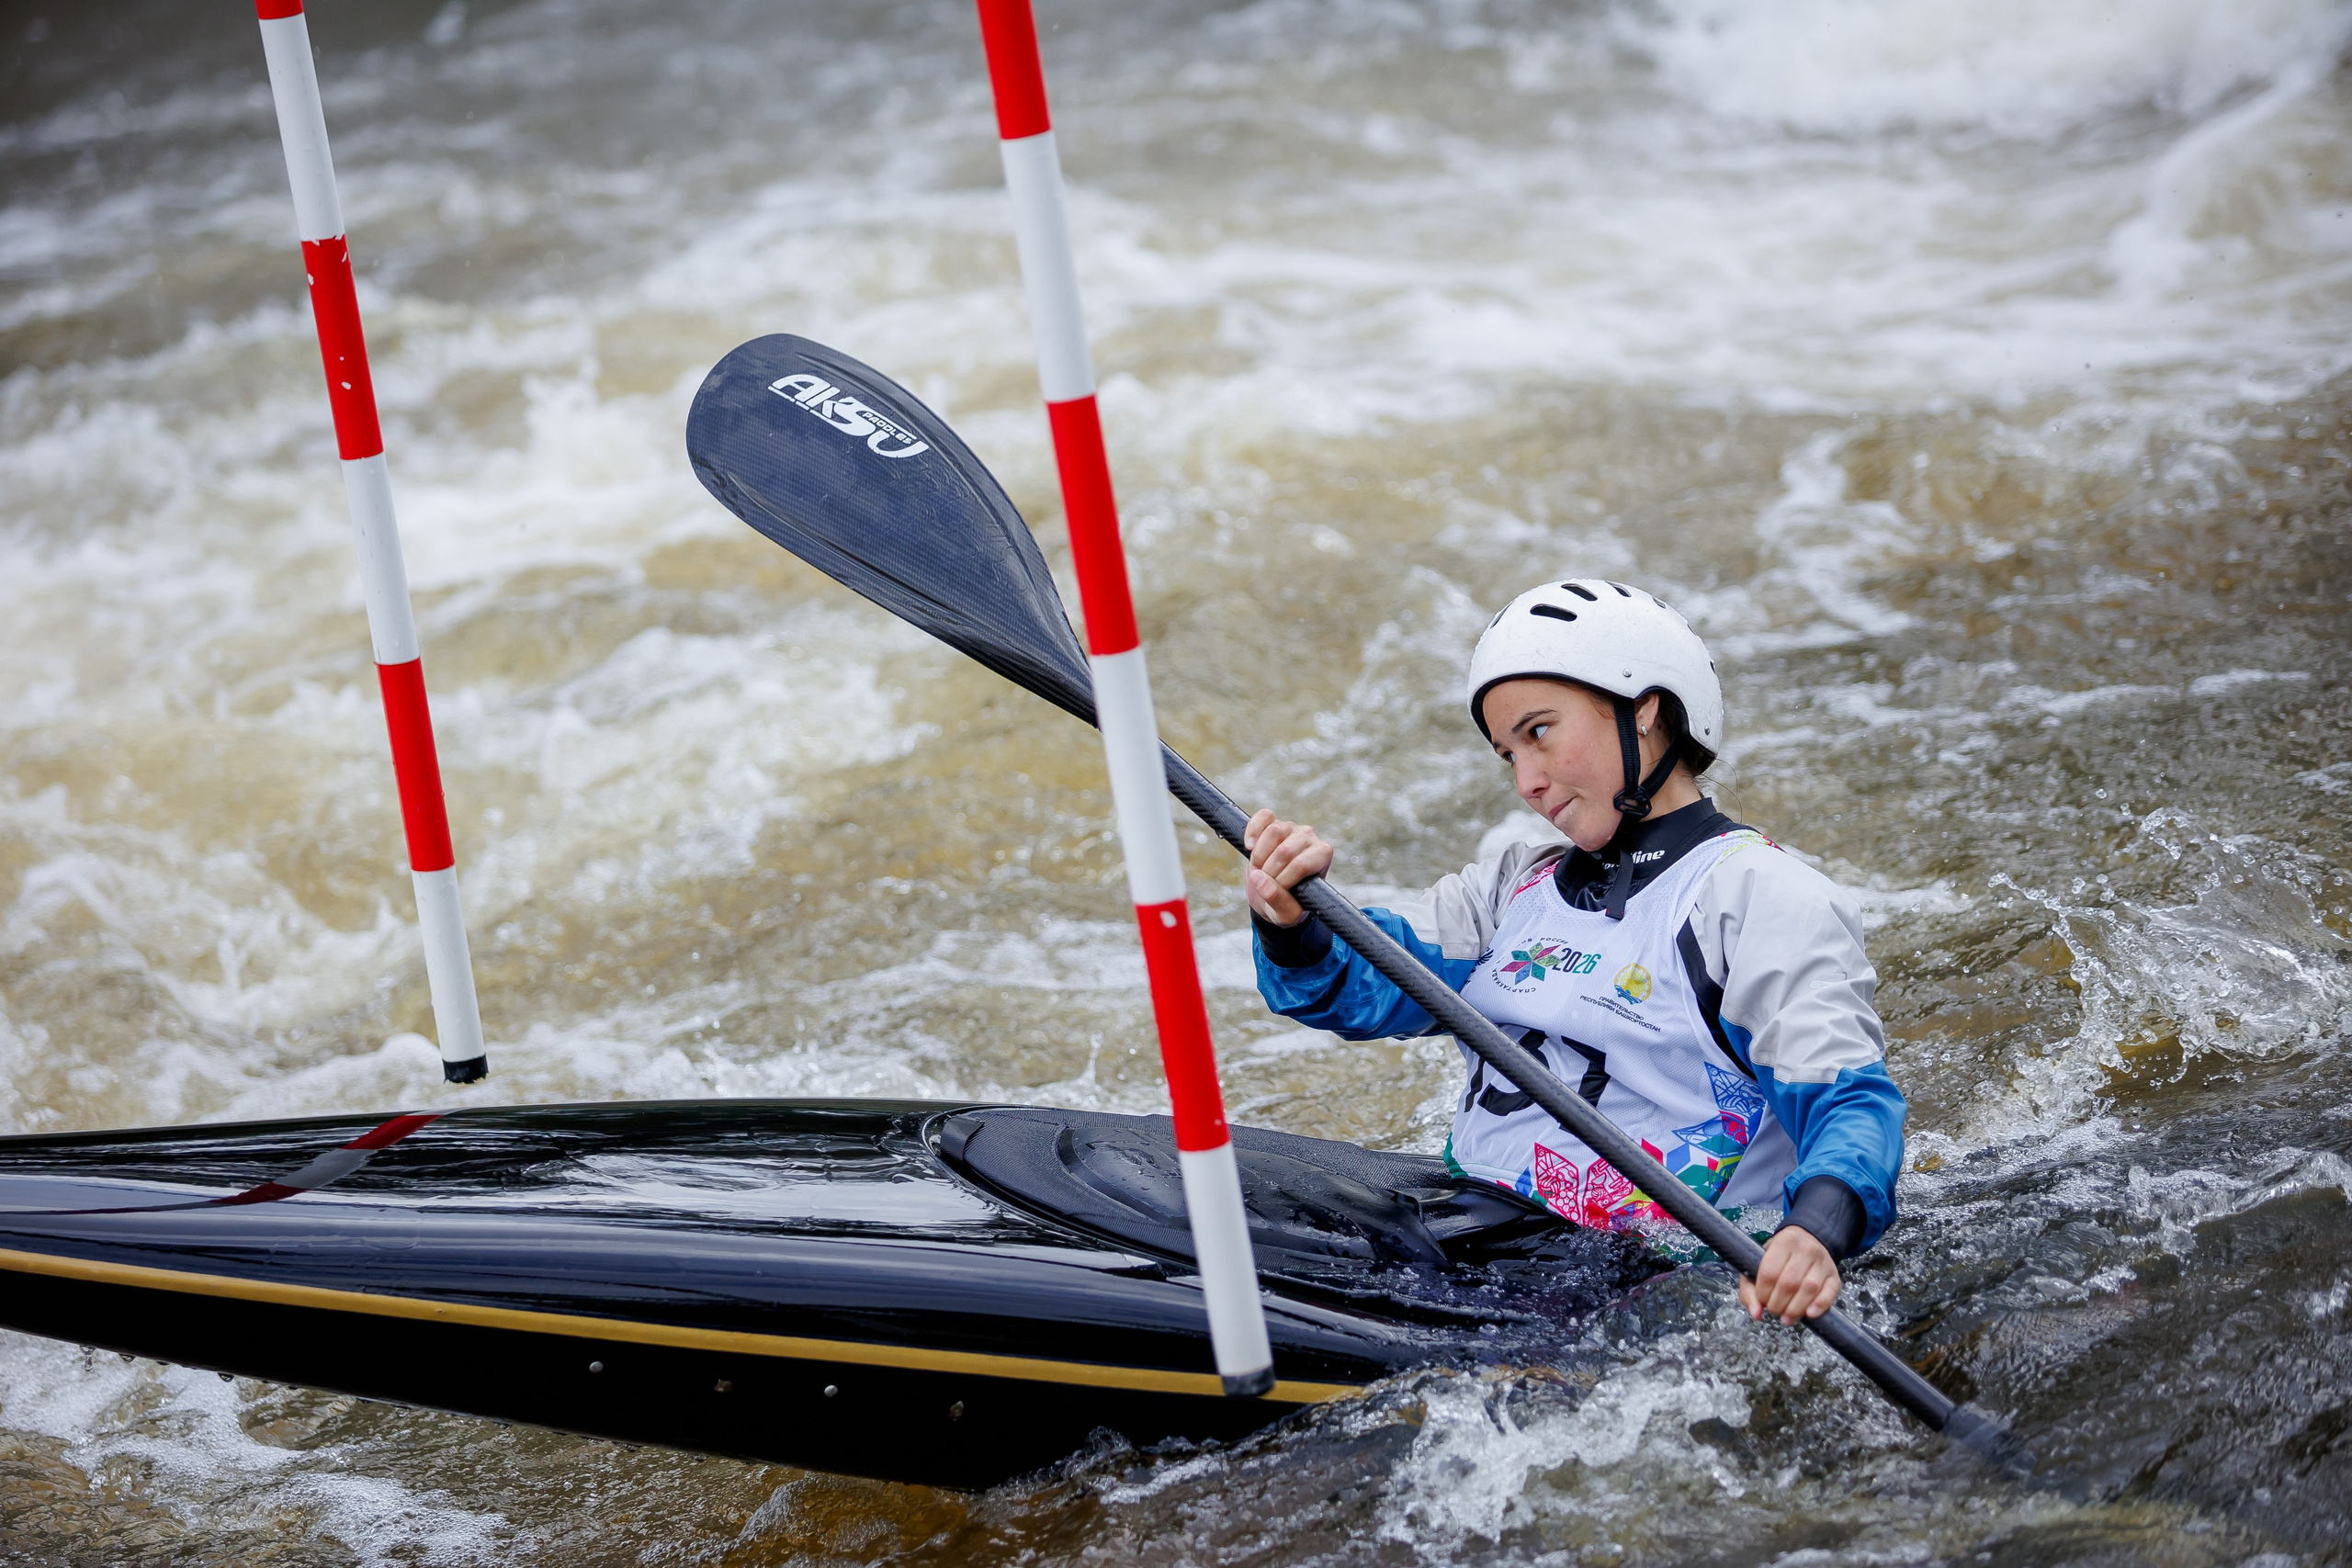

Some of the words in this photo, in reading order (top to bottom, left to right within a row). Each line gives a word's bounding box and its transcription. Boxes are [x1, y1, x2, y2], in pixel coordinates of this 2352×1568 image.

[767, 374, 930, 458] AKSU
[862, 411, 912, 445] PADDLES
[1552, 947, 1602, 975] 2026
[1491, 967, 1536, 993] СПАРТАКИАДА
[1579, 995, 1615, 1012] РЕСПУБЛИКИ
[1615, 1009, 1661, 1032] БАШКОРТОСТАН
[1599, 996, 1644, 1021] ПРАВИТЕЛЬСТВО
